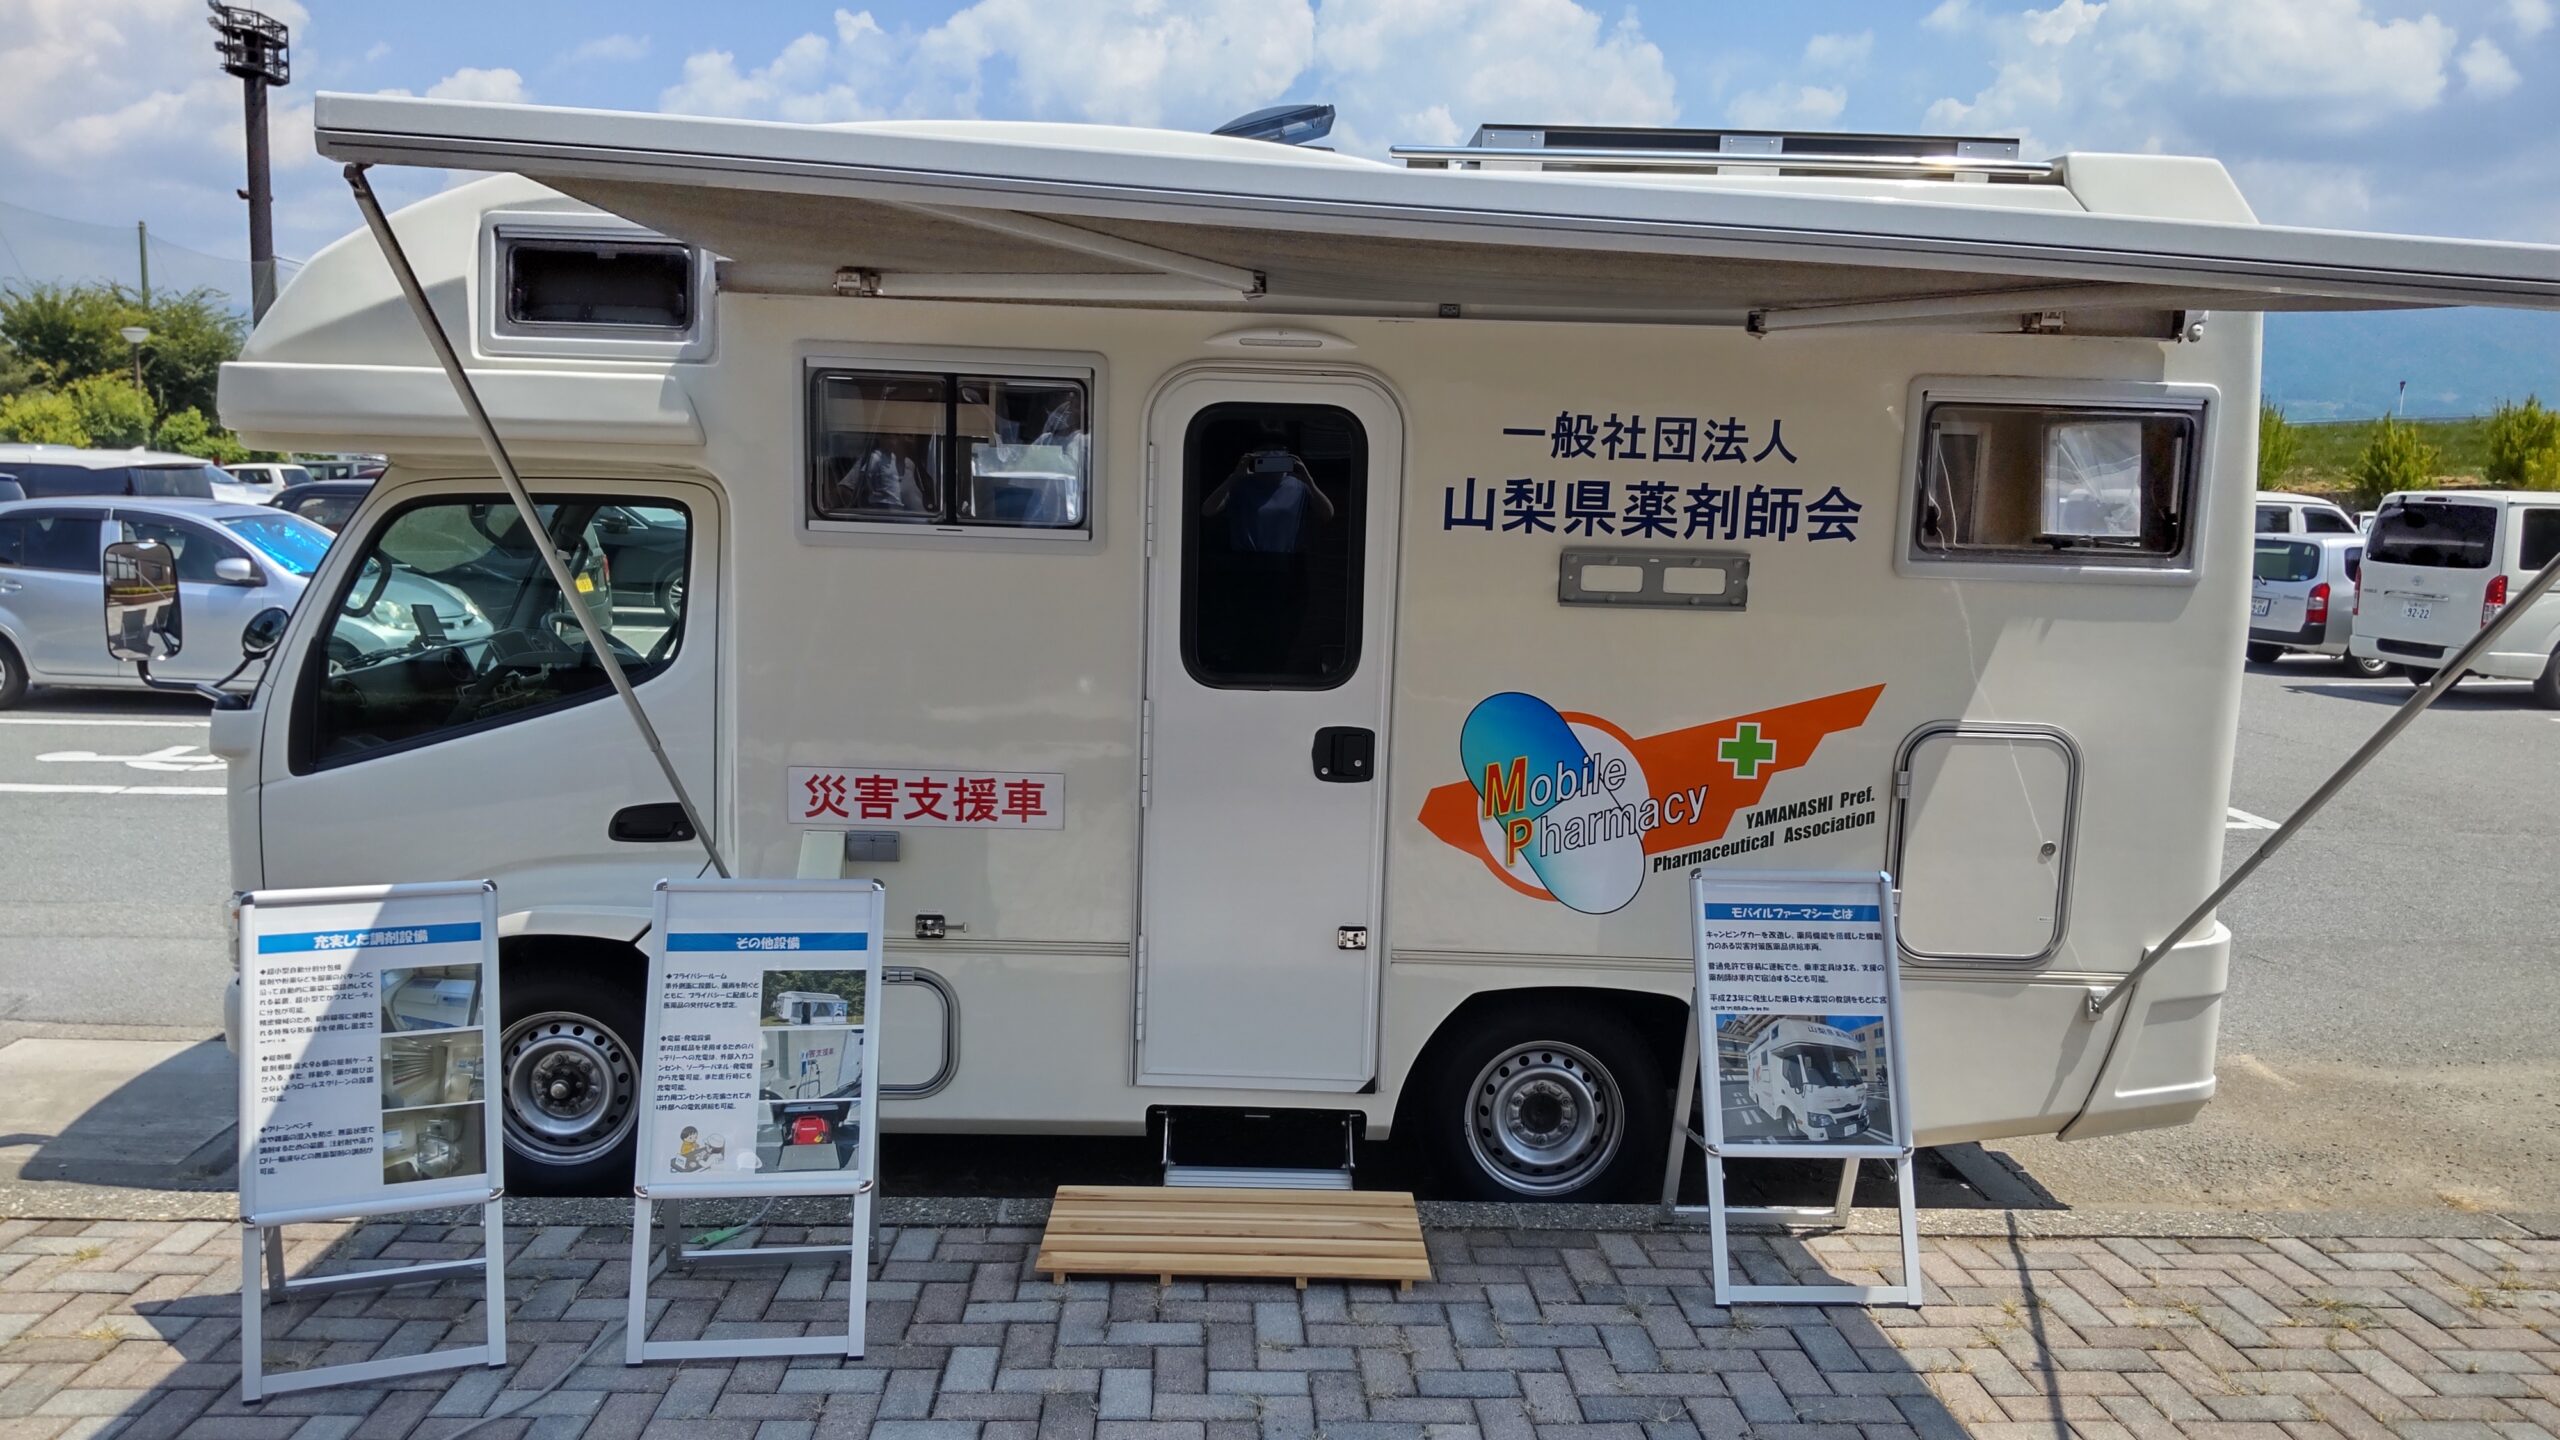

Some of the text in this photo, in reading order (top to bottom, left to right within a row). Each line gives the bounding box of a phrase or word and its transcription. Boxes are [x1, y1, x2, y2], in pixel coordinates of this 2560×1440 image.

[1502, 410, 1798, 465] 一般社団法人
[1443, 477, 1863, 543] 山梨県薬剤師会
[804, 773, 1049, 824] 災害支援車
[1482, 750, 1628, 820] Mobile
[1746, 785, 1876, 830] YAMANASHI Pref.
[1504, 782, 1709, 867] Pharmacy
[1652, 809, 1876, 874] Pharmaceutical Association
[313, 929, 428, 949] 充実した調剤設備
[1731, 906, 1854, 920] モバイルファーマシーとは
[735, 936, 801, 950] その他設備
